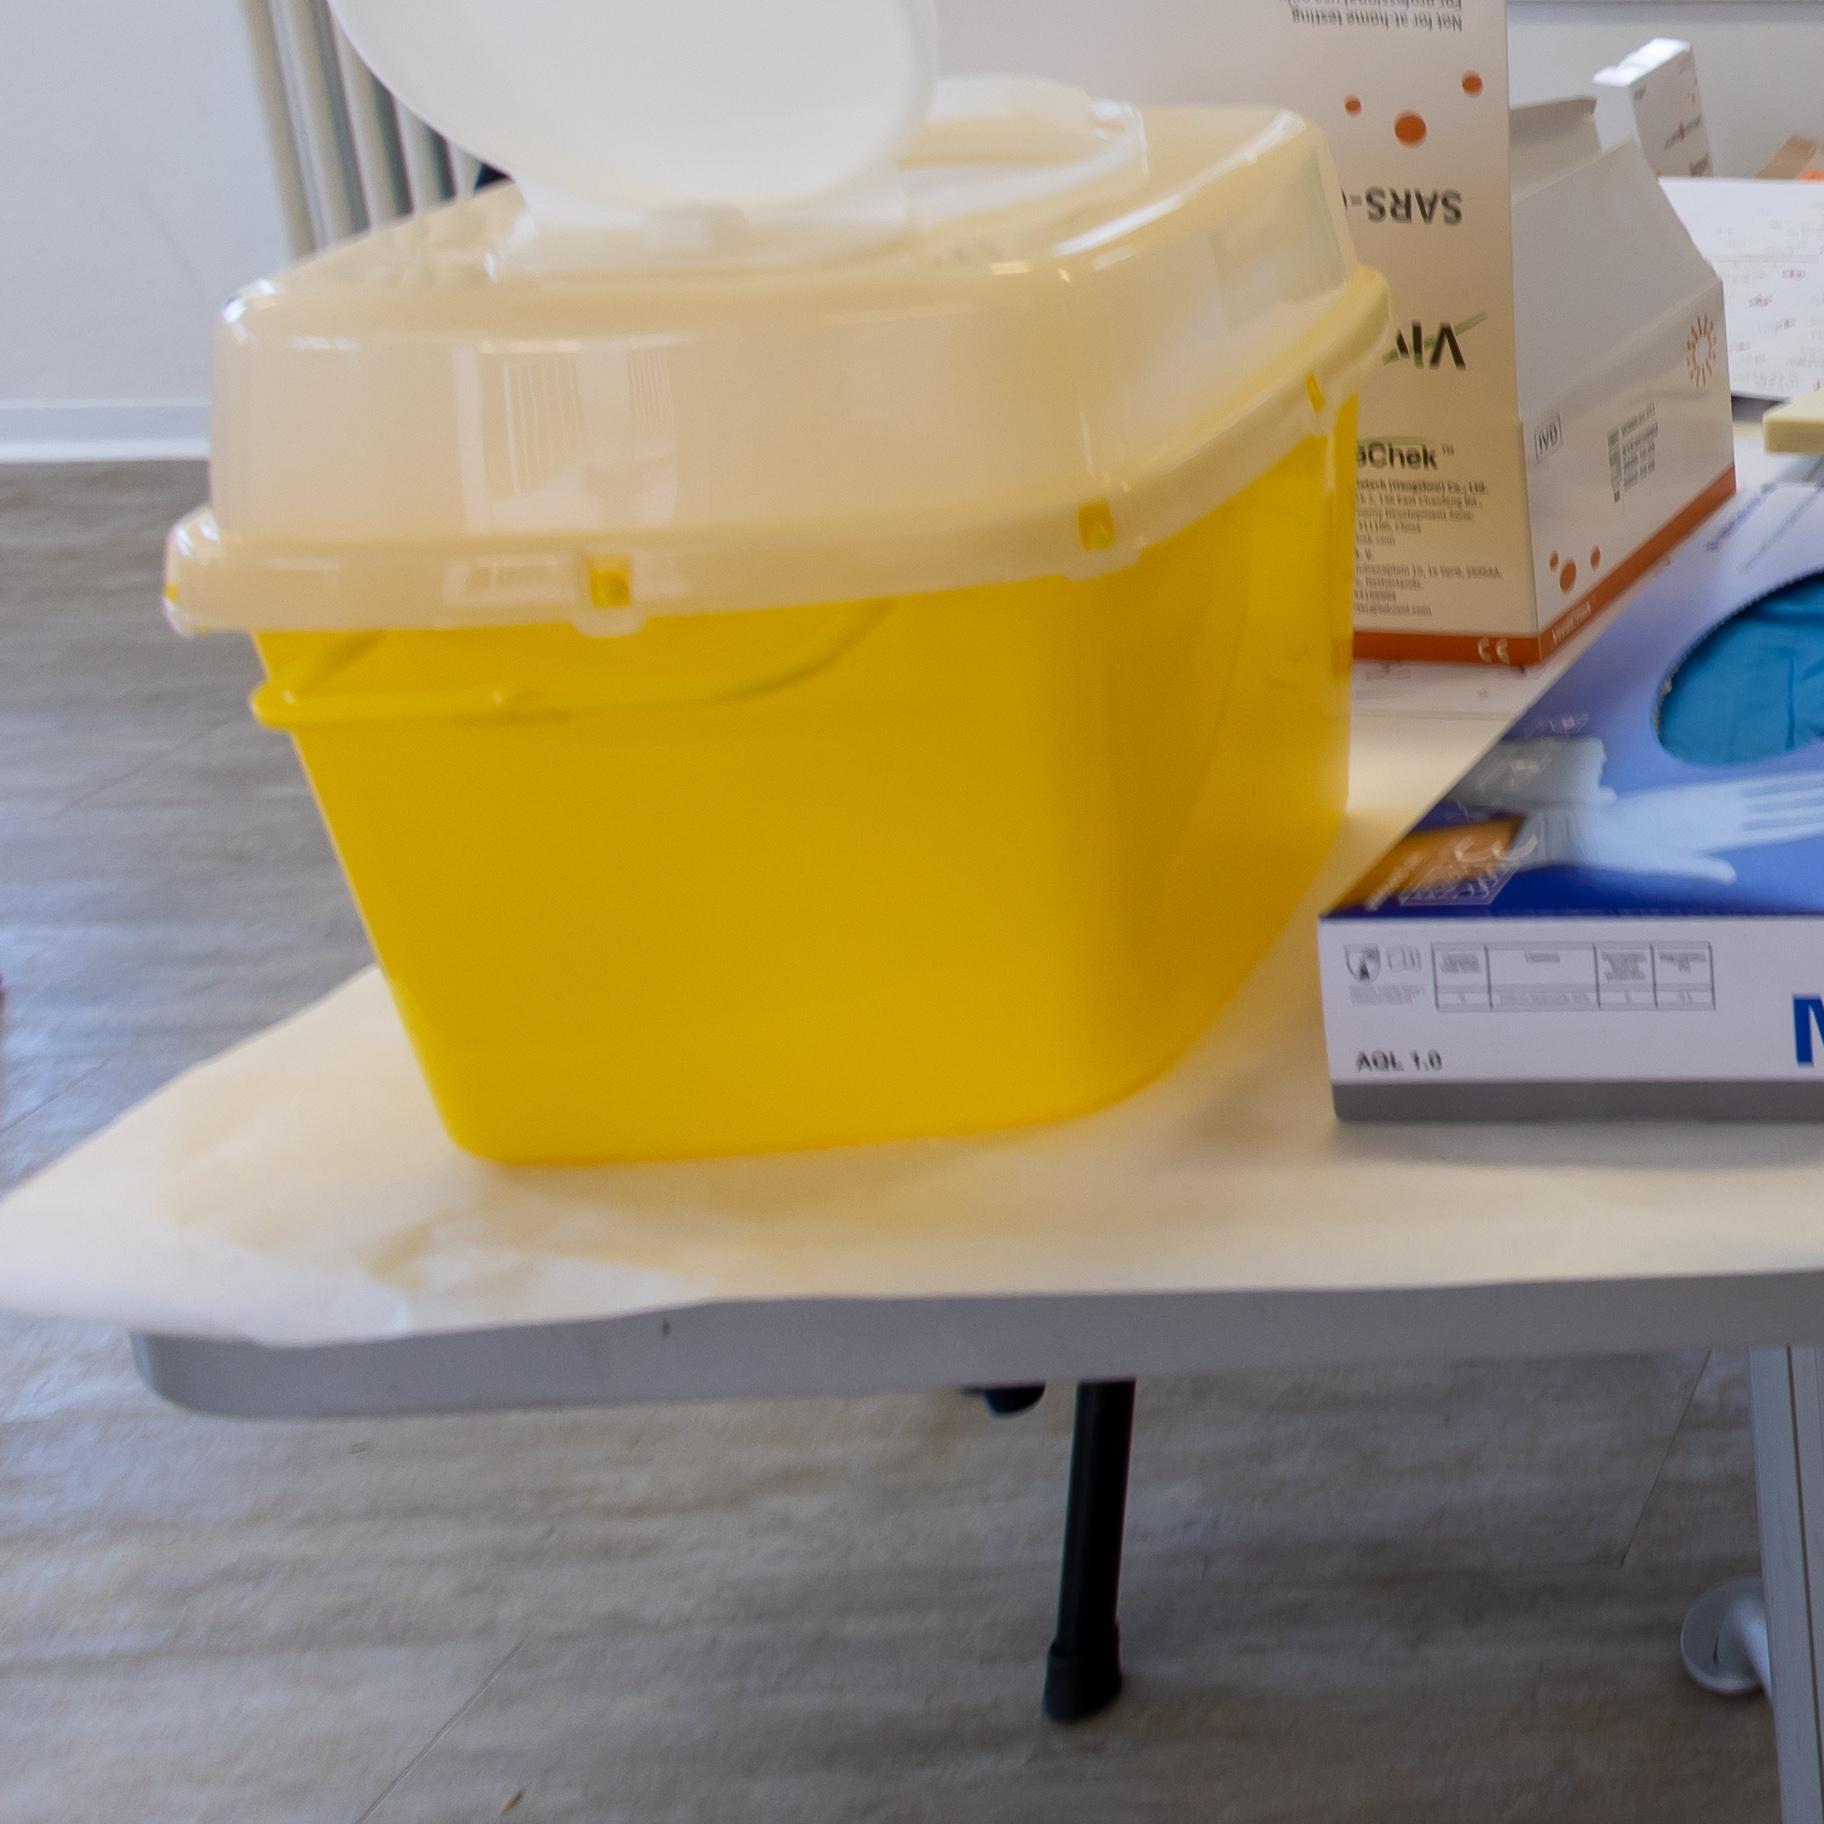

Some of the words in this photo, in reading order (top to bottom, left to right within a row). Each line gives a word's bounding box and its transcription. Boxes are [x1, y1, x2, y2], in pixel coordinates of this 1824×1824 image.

[1291, 4, 1342, 27] testing
[1437, 10, 1462, 31] Not
[1538, 423, 1558, 451] IVD
[1356, 1050, 1404, 1073] AQL
[1412, 1049, 1443, 1071] 1.0
